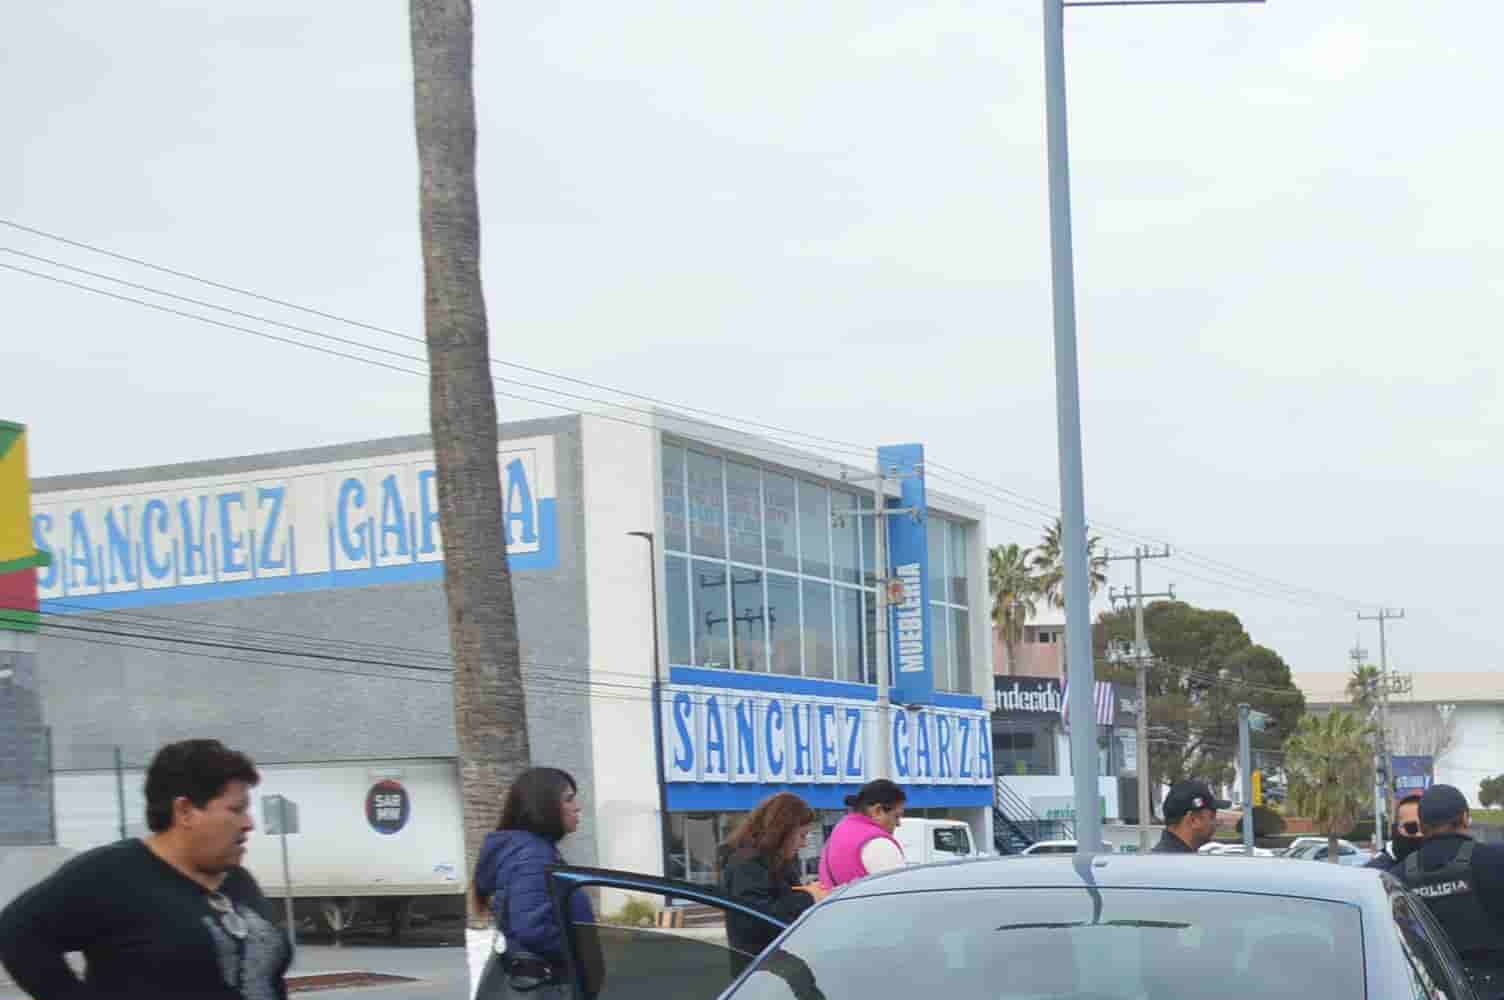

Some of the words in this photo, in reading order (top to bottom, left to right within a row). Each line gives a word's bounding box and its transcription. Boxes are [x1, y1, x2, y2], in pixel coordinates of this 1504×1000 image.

[32, 484, 287, 589] SANCHEZ
[337, 457, 538, 562] GAA
[673, 692, 862, 776] SANCHEZ
[892, 709, 992, 778] GARZA
[995, 682, 1062, 713] ndecido
